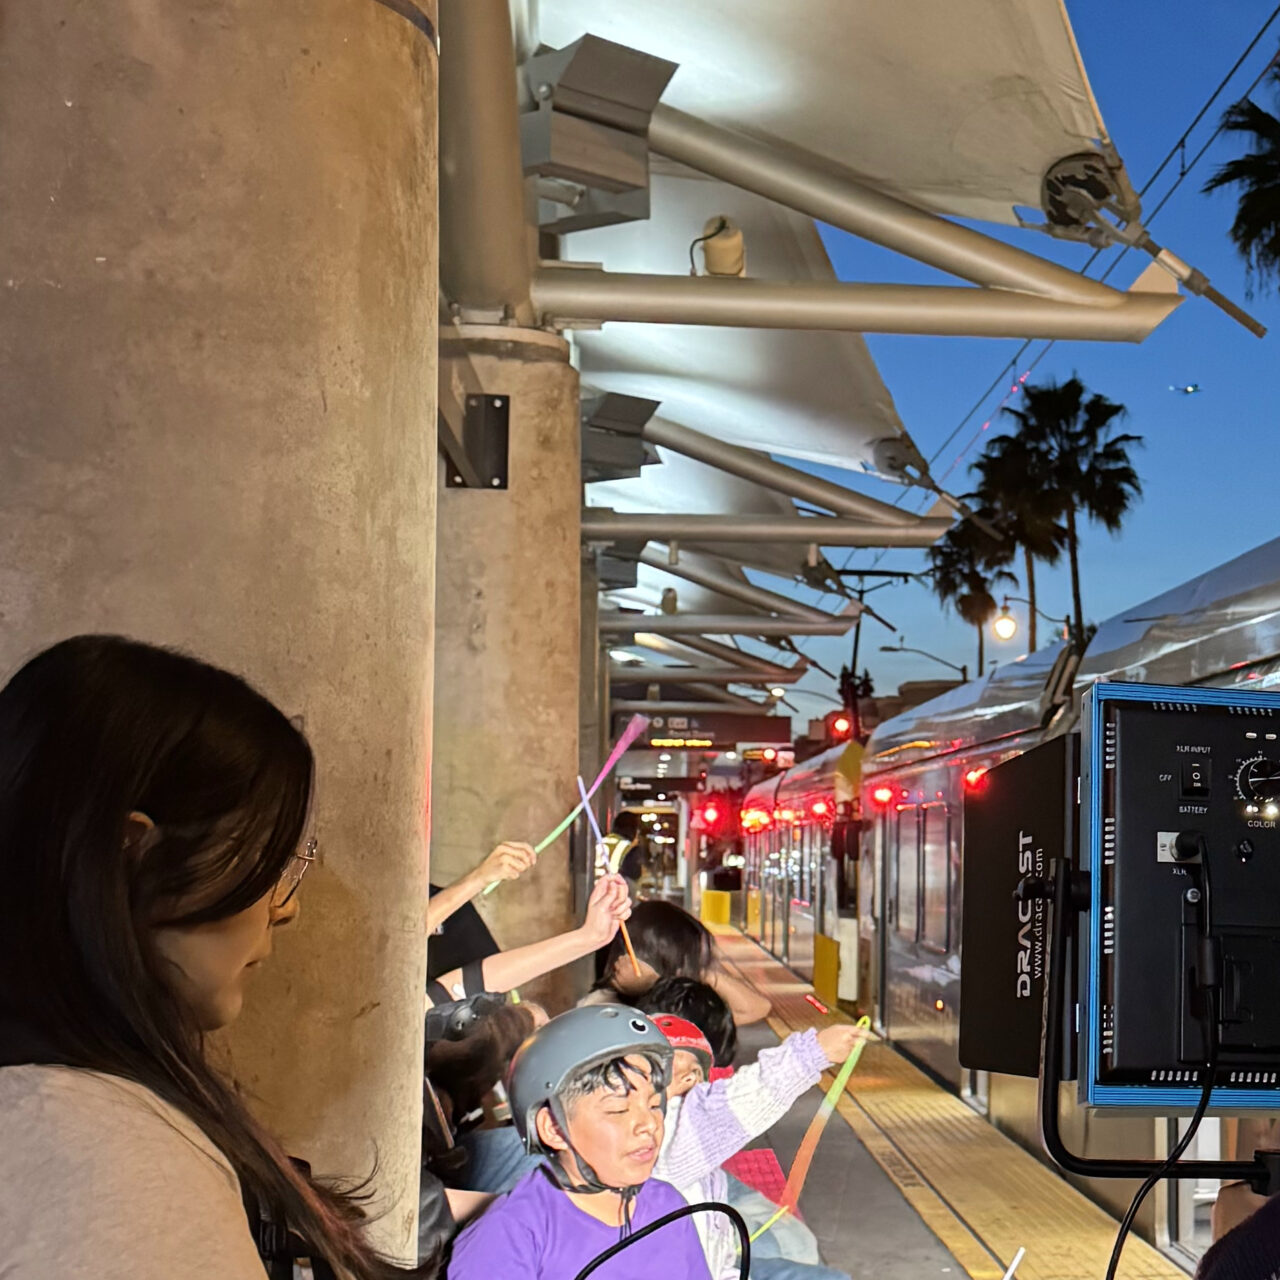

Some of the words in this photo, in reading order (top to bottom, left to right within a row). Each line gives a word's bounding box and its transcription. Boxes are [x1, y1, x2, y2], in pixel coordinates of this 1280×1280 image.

[1179, 806, 1209, 815] BATTERY
[1247, 820, 1277, 829] COLOR
[1016, 830, 1033, 998] DRACST
[1033, 848, 1044, 979] www.dracacom
